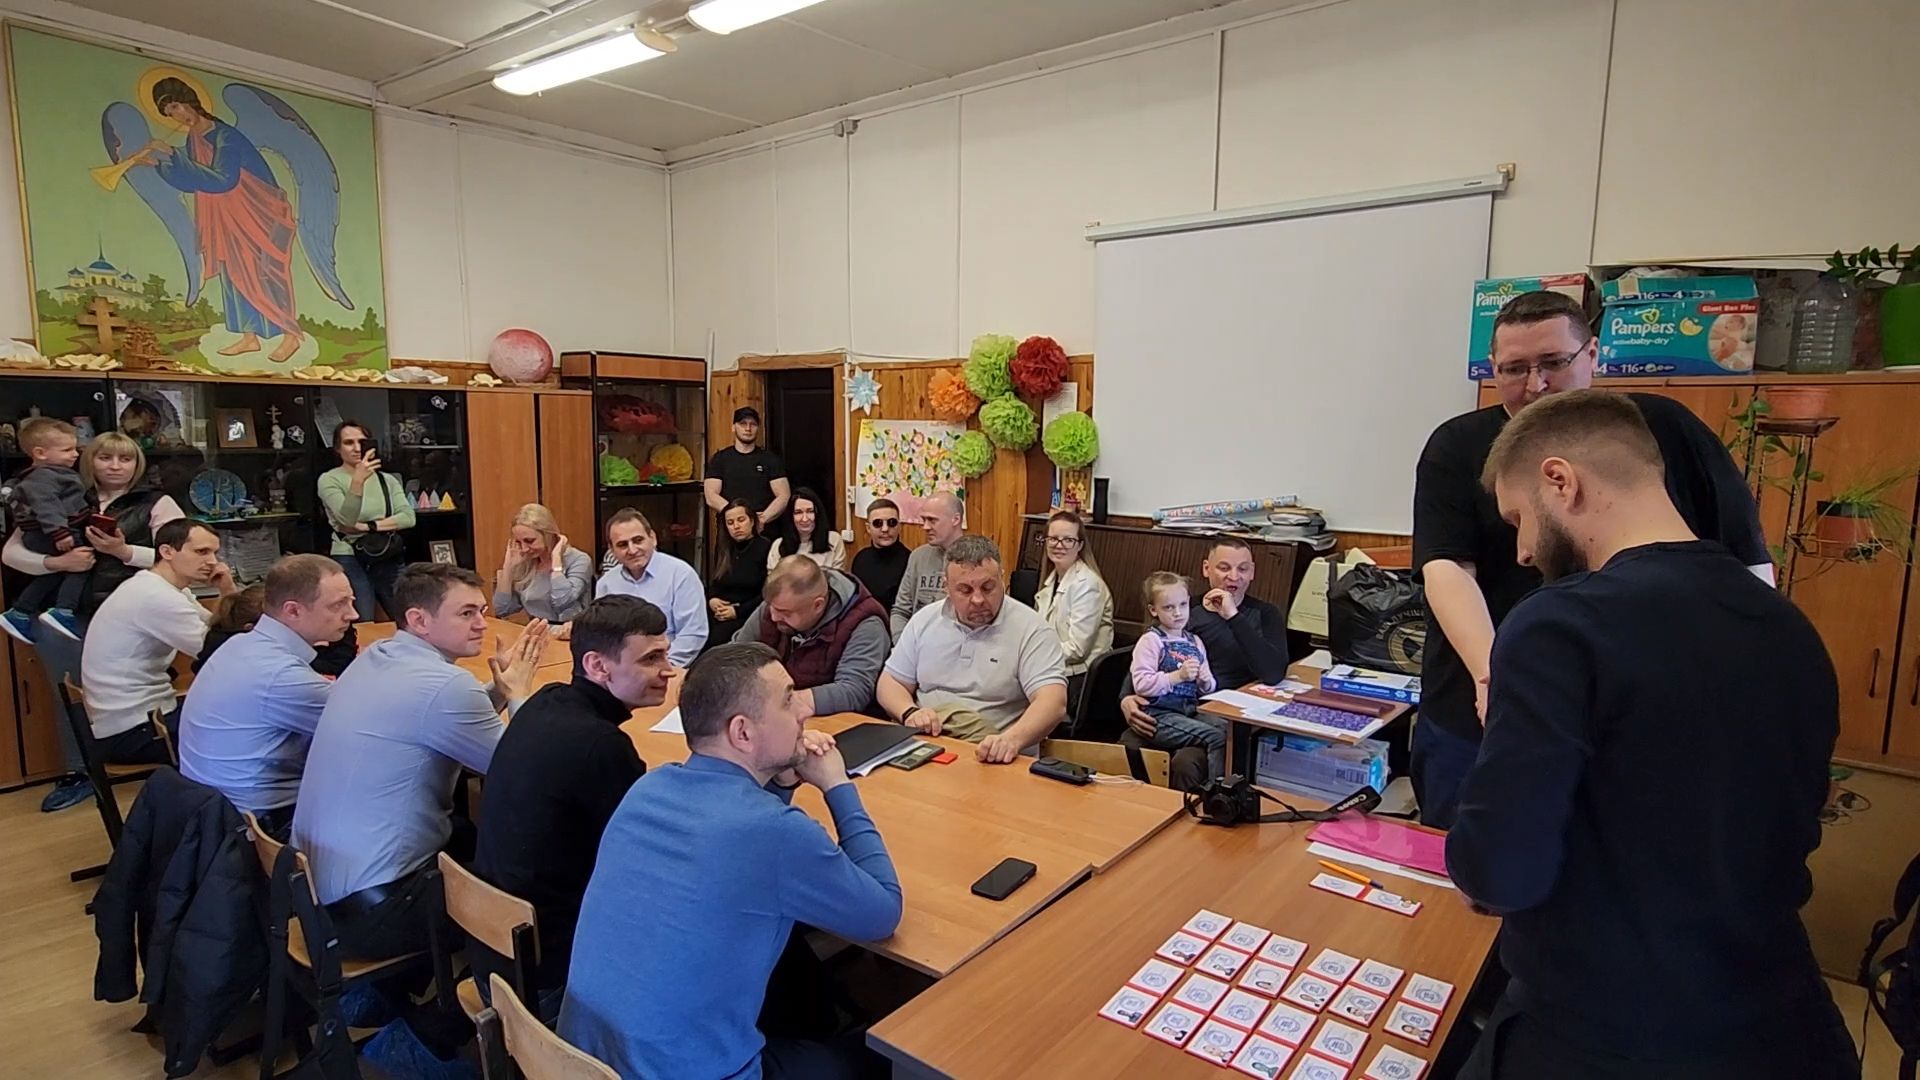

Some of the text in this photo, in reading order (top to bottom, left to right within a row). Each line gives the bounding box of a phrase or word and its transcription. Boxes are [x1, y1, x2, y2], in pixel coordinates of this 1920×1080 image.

[1476, 292, 1517, 310] Pampe
[1611, 317, 1675, 337] Pampers
[1470, 366, 1478, 376] 5
[1337, 794, 1367, 811] Canon
